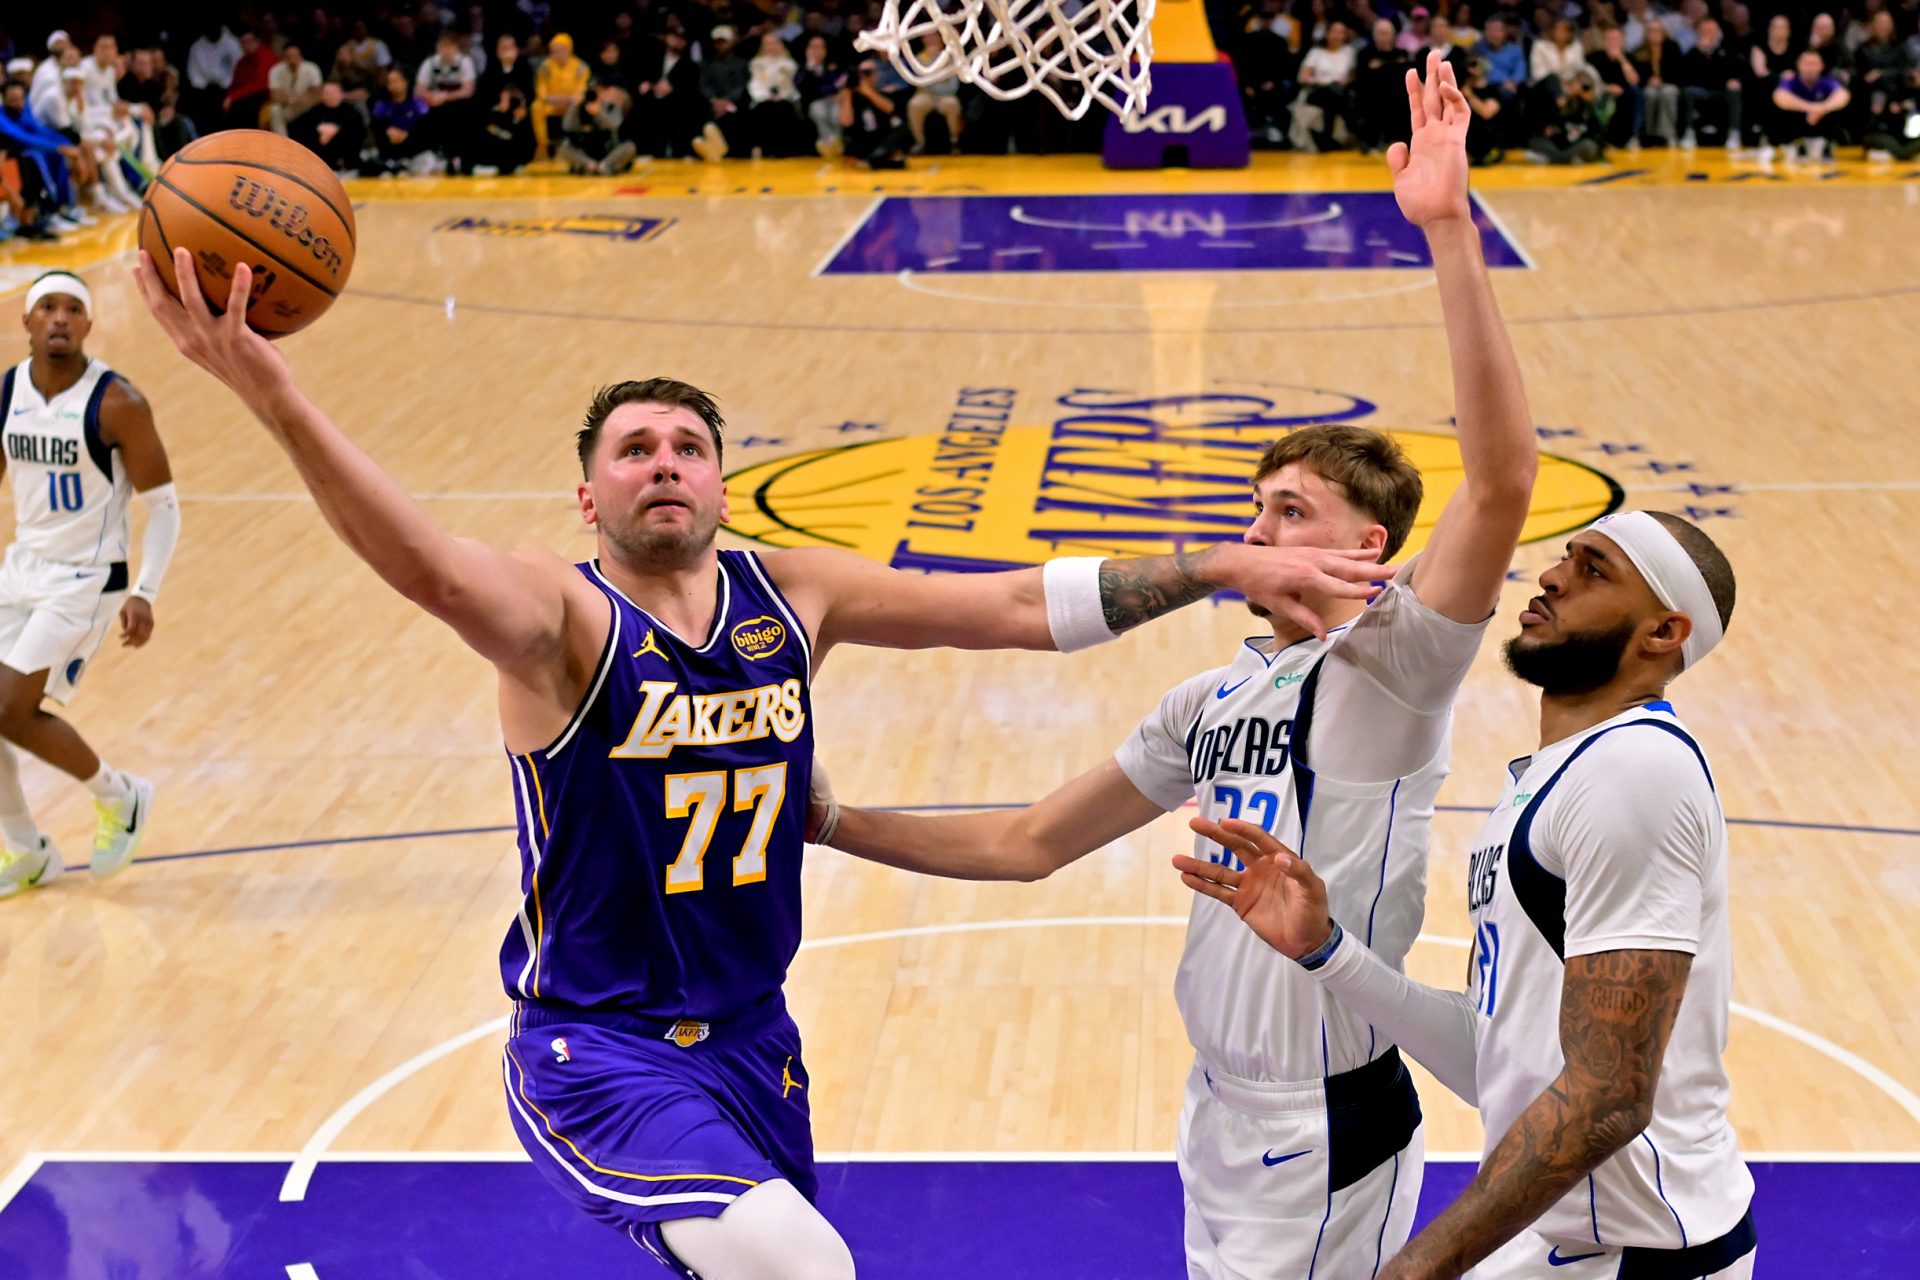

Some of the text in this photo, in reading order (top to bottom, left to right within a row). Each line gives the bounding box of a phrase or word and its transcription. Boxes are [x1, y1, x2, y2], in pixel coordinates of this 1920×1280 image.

[229, 174, 343, 277] Wilson
[7, 432, 78, 466] DALLAS
[906, 387, 1018, 532] LOS ANGELES
[47, 470, 84, 512] 10
[734, 625, 782, 648] bibigo
[608, 678, 805, 759] LAKERS
[664, 761, 788, 895] 77
